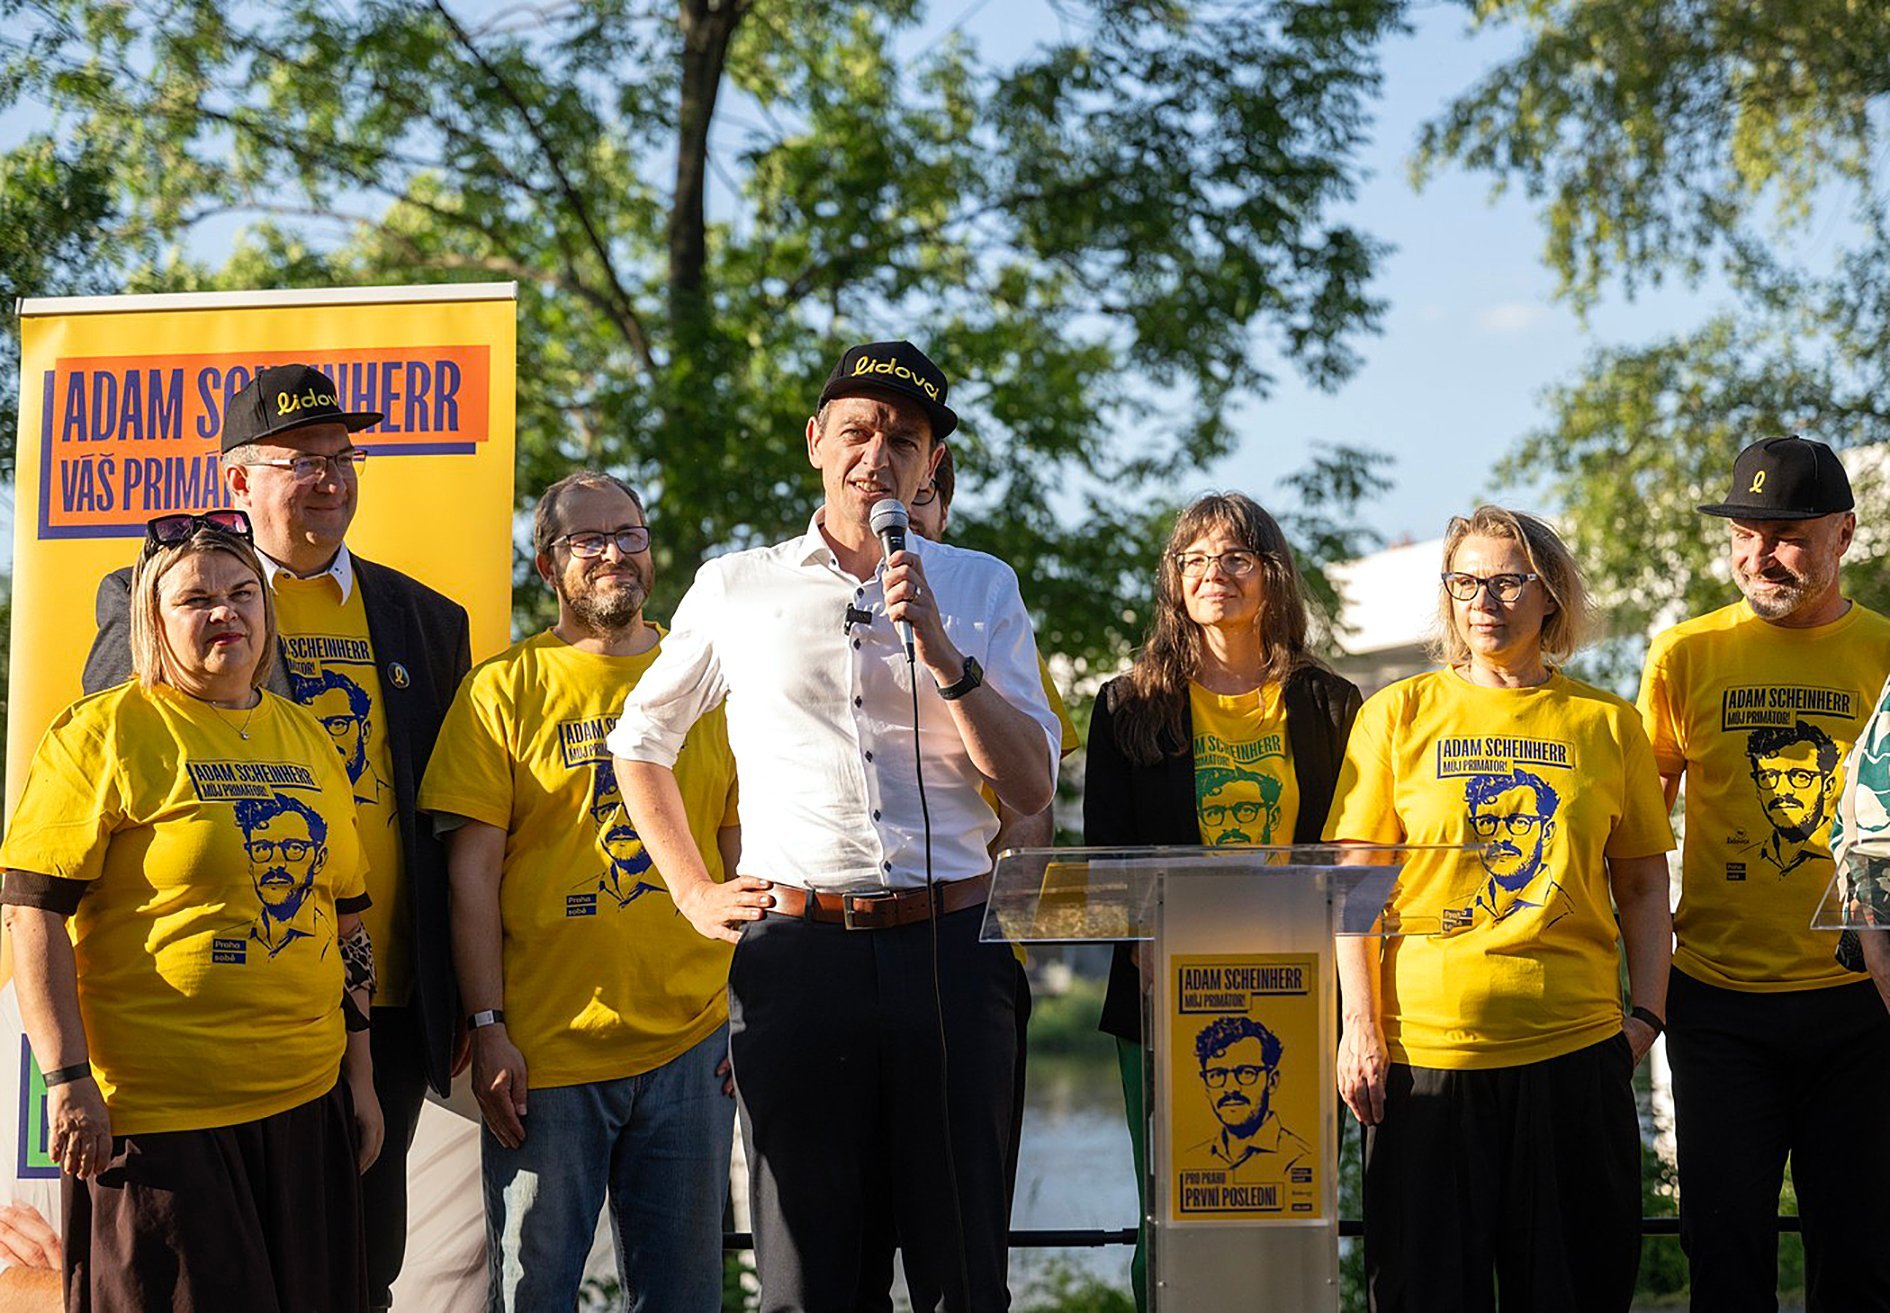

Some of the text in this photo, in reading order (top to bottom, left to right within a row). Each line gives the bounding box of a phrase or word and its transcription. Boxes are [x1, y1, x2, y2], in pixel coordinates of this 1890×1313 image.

[61, 368, 184, 442] ADAM
[61, 452, 115, 512] VÁŠ
[289, 637, 370, 660] SCHEINHERR
[1728, 687, 1850, 713] ADAM SCHEINHERR
[566, 718, 605, 745] ADAM
[1443, 737, 1567, 763] ADAM SCHEINHERR
[193, 763, 315, 787] ADAM SCHEINHERR
[1185, 967, 1303, 991] ADAM SCHEINHERR
[1185, 1184, 1277, 1208] PRVNÍ POSLEDNÍ
